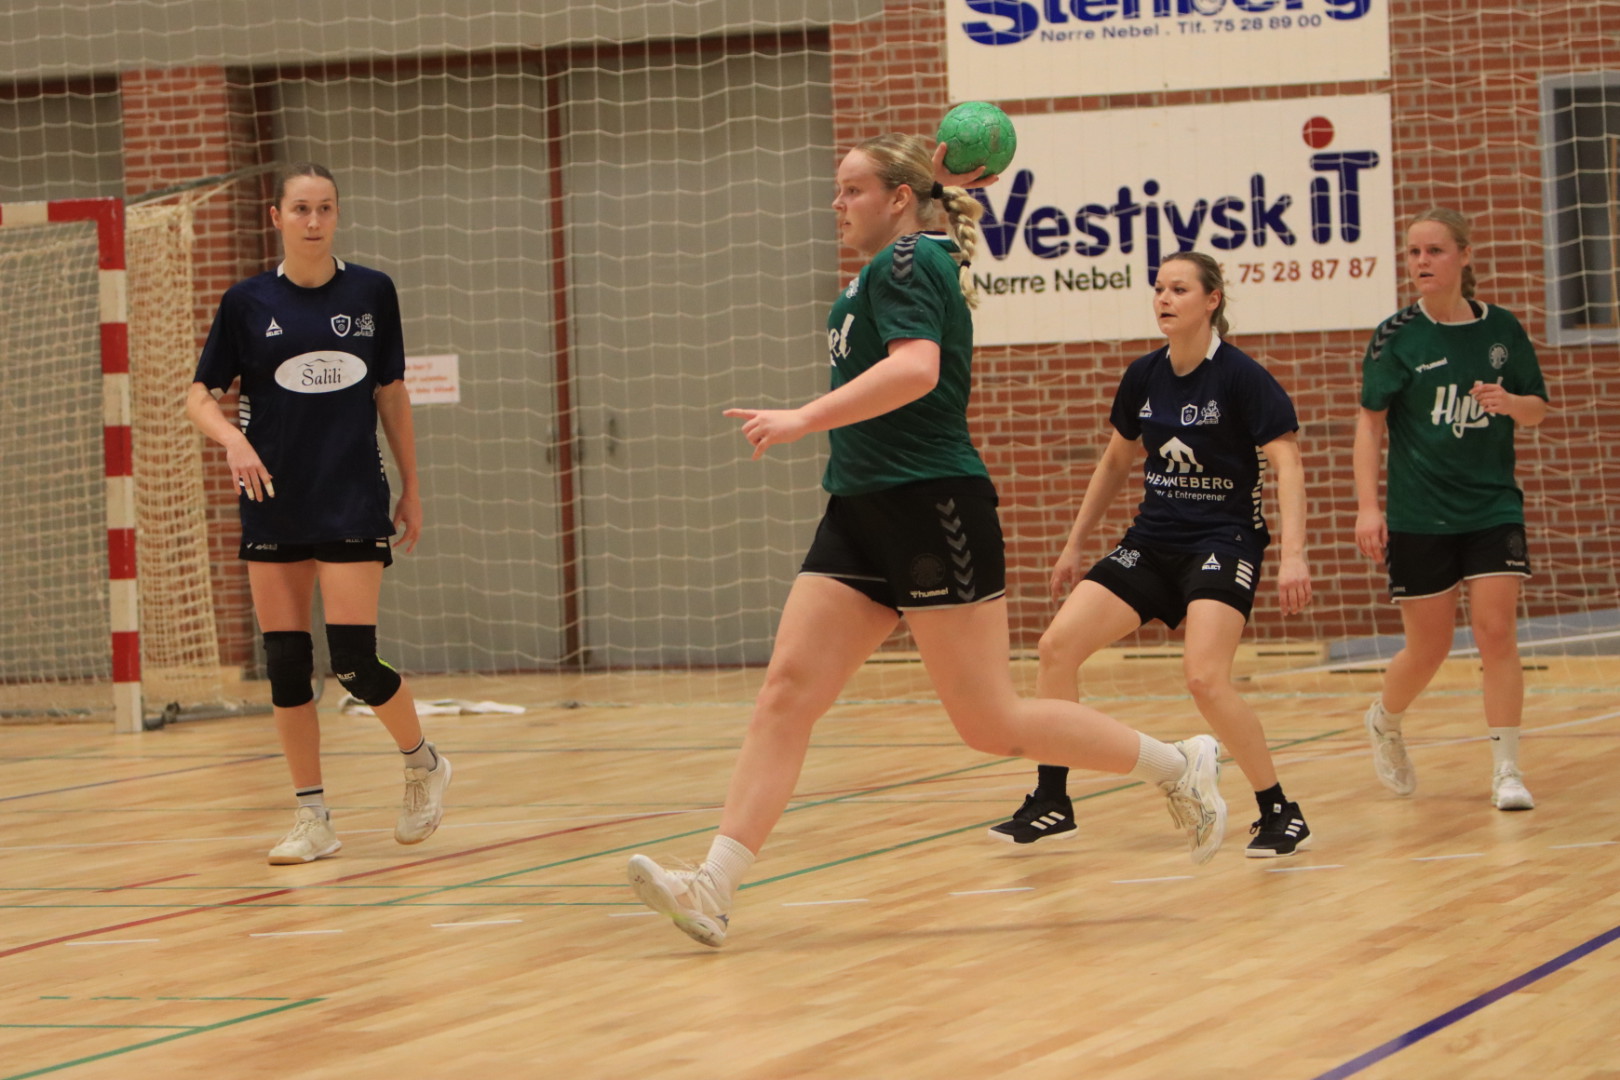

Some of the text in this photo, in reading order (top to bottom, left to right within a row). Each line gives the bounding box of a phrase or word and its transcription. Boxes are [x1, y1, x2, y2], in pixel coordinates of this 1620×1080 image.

[1040, 28, 1095, 42] Nørre
[1102, 24, 1160, 38] Nebel
[1177, 21, 1206, 35] Tlf.
[1213, 19, 1235, 33] 75
[1240, 17, 1263, 31] 28
[1269, 15, 1292, 29] 89
[1298, 14, 1322, 27] 00
[965, 168, 1297, 287] Vestjysk
[973, 264, 1132, 296] Nørre Nebel
[1238, 262, 1266, 284] 75
[1272, 260, 1301, 283] 28
[1311, 259, 1340, 281] 87
[1349, 257, 1378, 279] 87
[1146, 471, 1234, 490] HENNEBERG
[1167, 490, 1173, 498] &
[1174, 490, 1227, 502] Entreprenør
[918, 587, 949, 598] hummel
